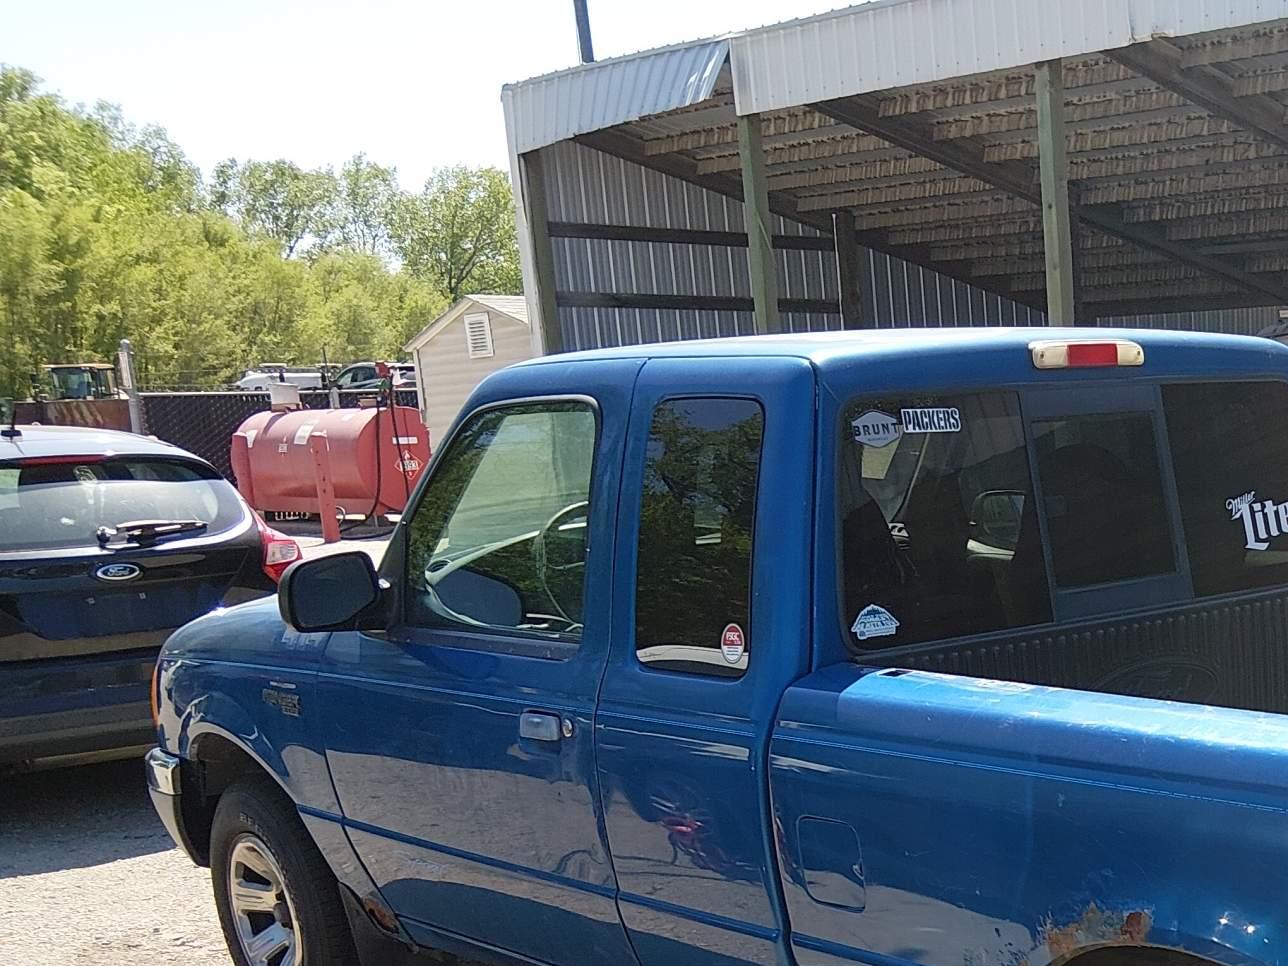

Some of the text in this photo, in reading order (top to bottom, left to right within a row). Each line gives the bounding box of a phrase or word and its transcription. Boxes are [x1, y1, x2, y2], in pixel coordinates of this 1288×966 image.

[853, 422, 899, 437] BRUNT
[902, 408, 960, 431] PACKERS
[1225, 491, 1256, 516] Miller
